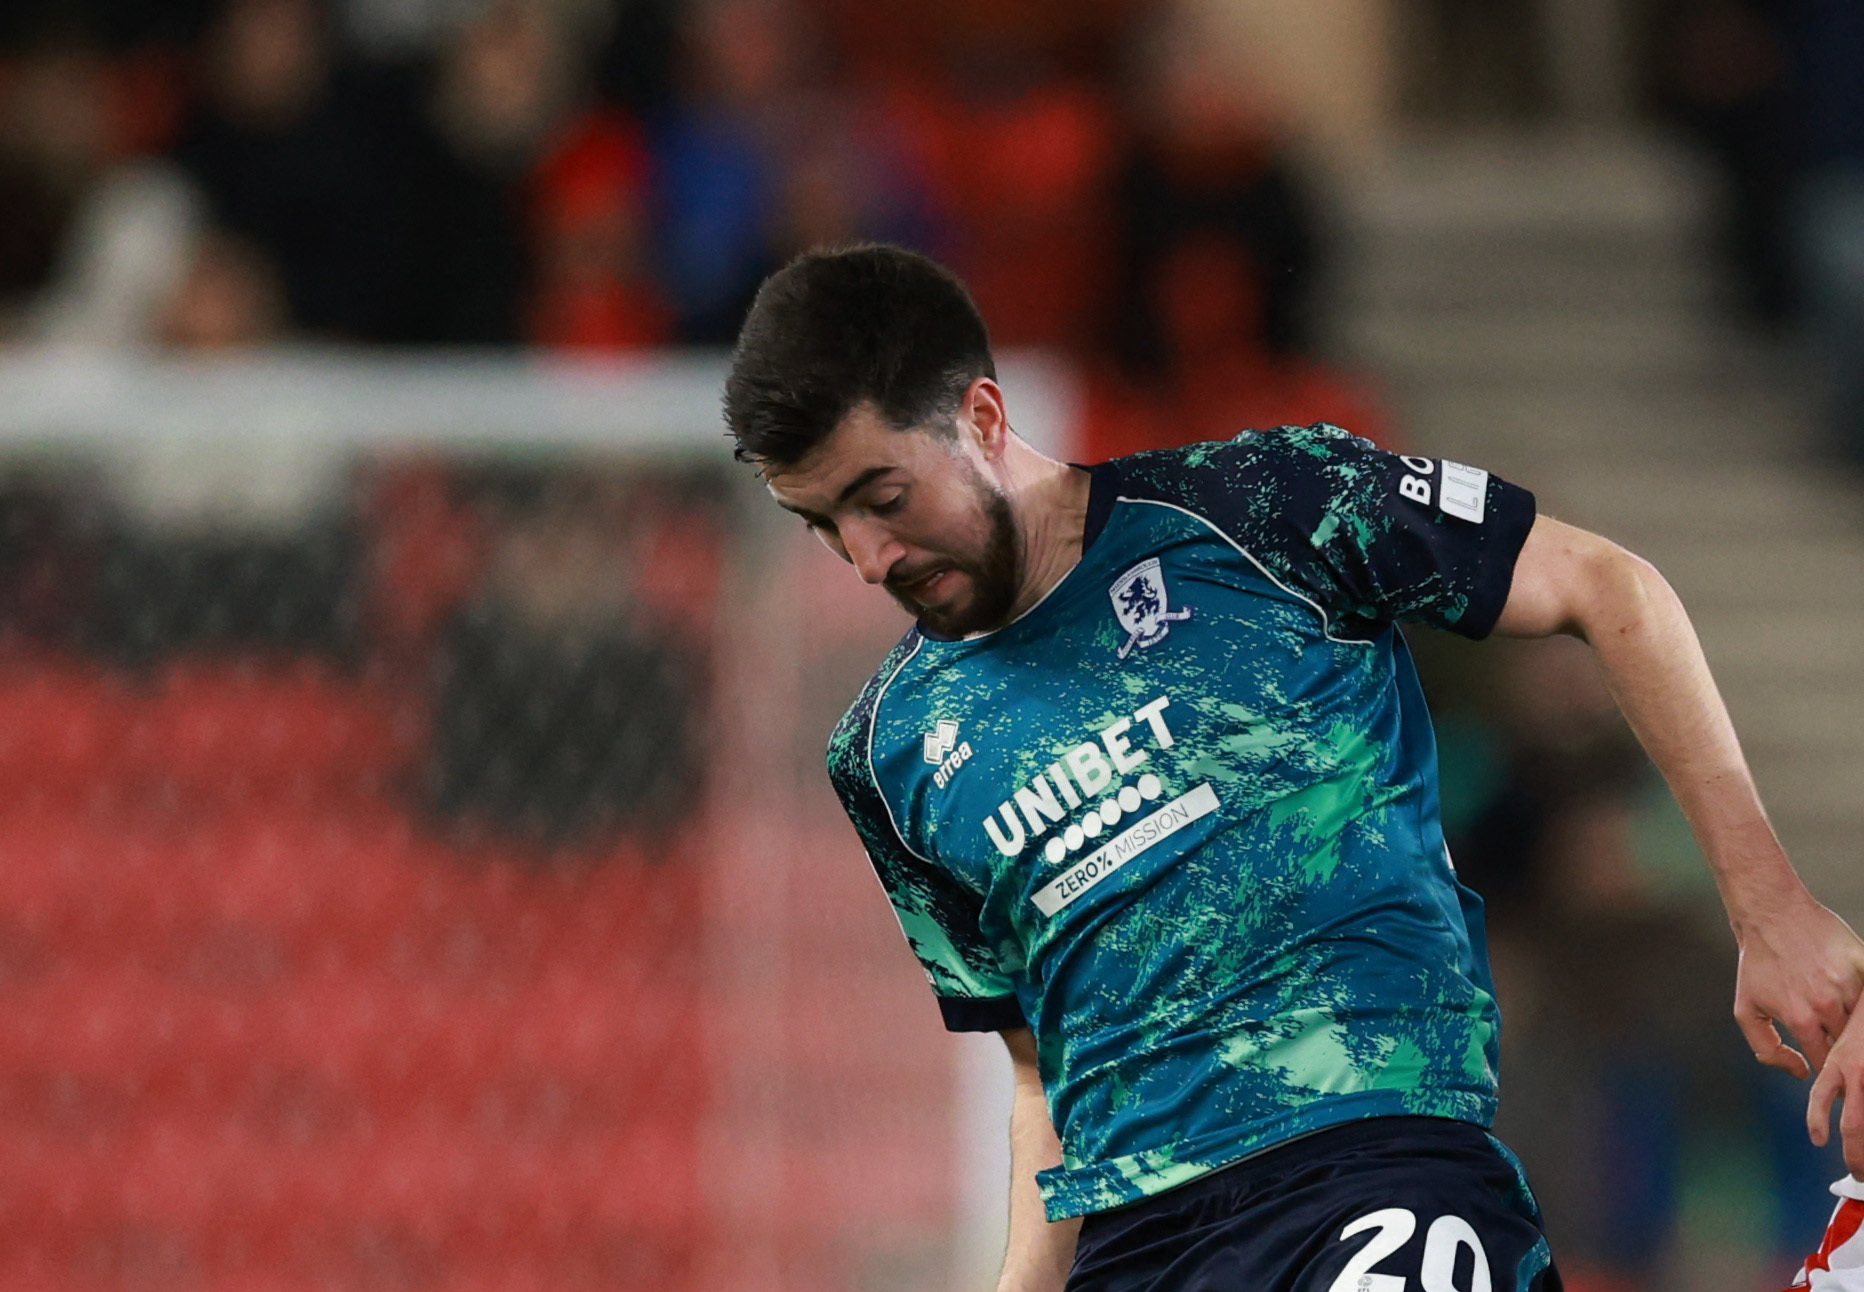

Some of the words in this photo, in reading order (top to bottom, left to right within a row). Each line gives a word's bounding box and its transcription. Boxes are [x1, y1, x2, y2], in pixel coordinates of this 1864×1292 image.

[933, 741, 973, 789] errea
[982, 695, 1174, 857] UNIBET
[1055, 851, 1113, 900] ZERO%
[1114, 803, 1189, 860] MISSION
